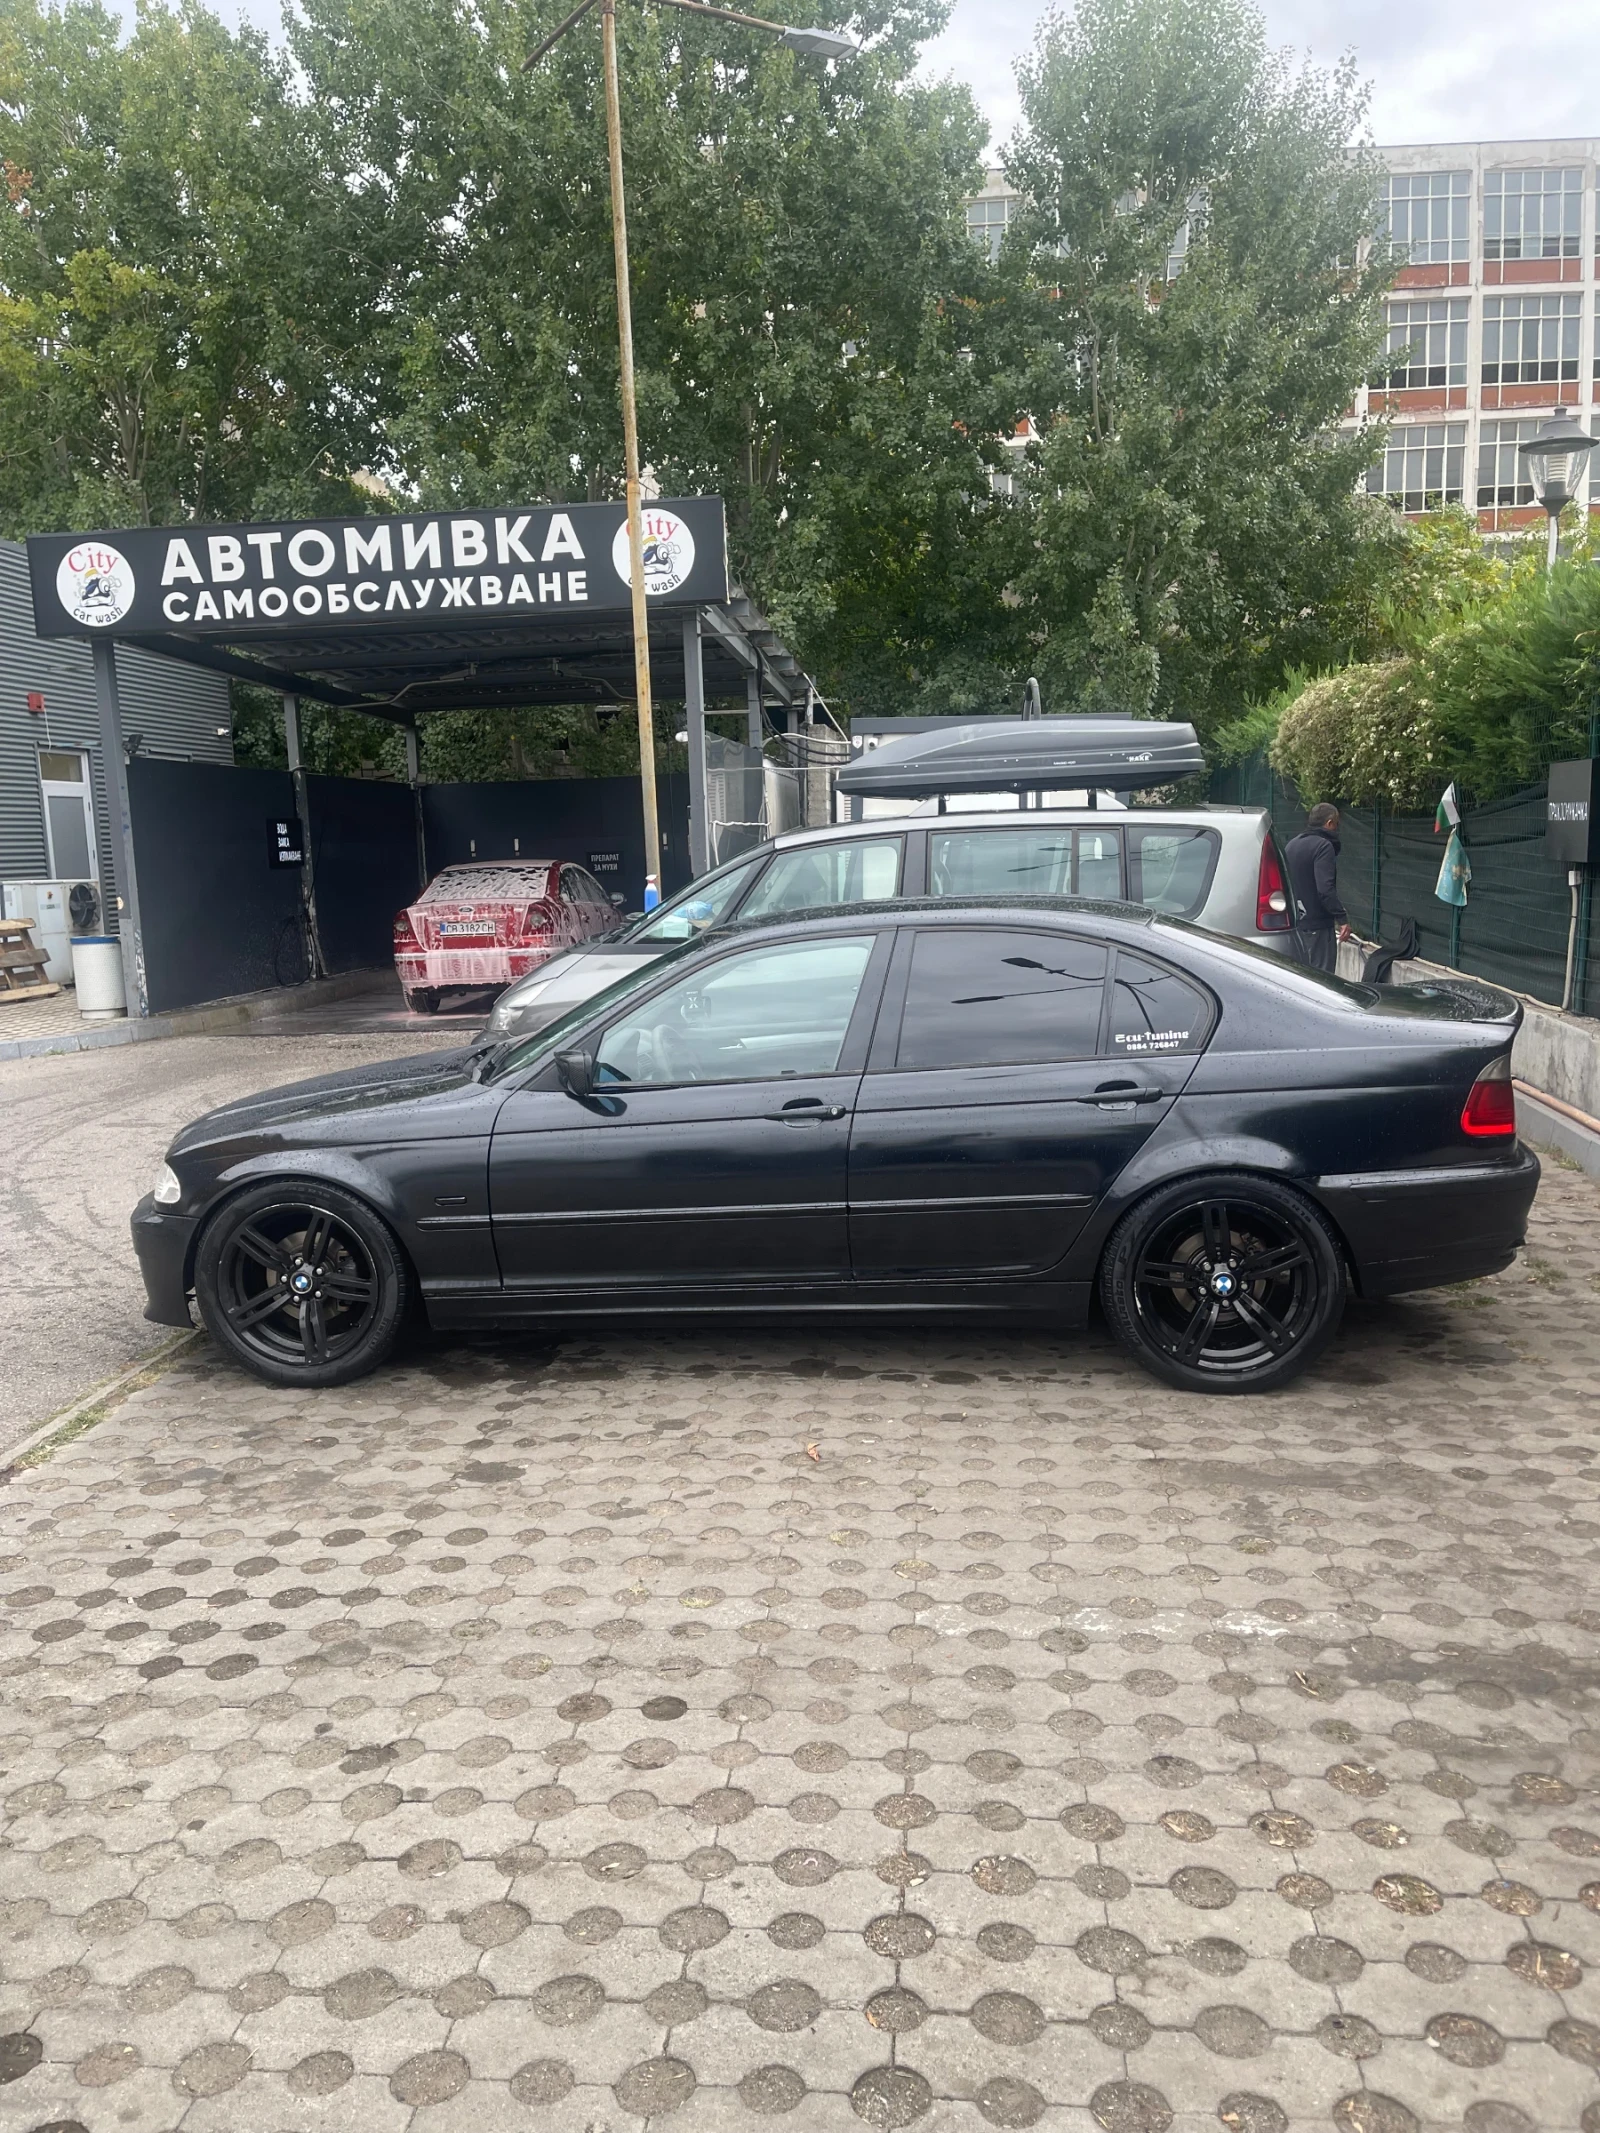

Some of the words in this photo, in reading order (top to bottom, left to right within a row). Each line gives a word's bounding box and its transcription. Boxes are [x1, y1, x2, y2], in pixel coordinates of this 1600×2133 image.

[160, 513, 586, 586] АВТОМИВКА
[68, 547, 119, 574] City
[651, 573, 681, 592] wash
[162, 570, 589, 623] САМООБСЛУЖВАНЕ
[73, 608, 92, 622] car
[95, 606, 123, 623] wash
[590, 854, 620, 862] ПРЕПАРАТ
[594, 864, 602, 872] ЗА
[602, 863, 618, 871] МУХИ
